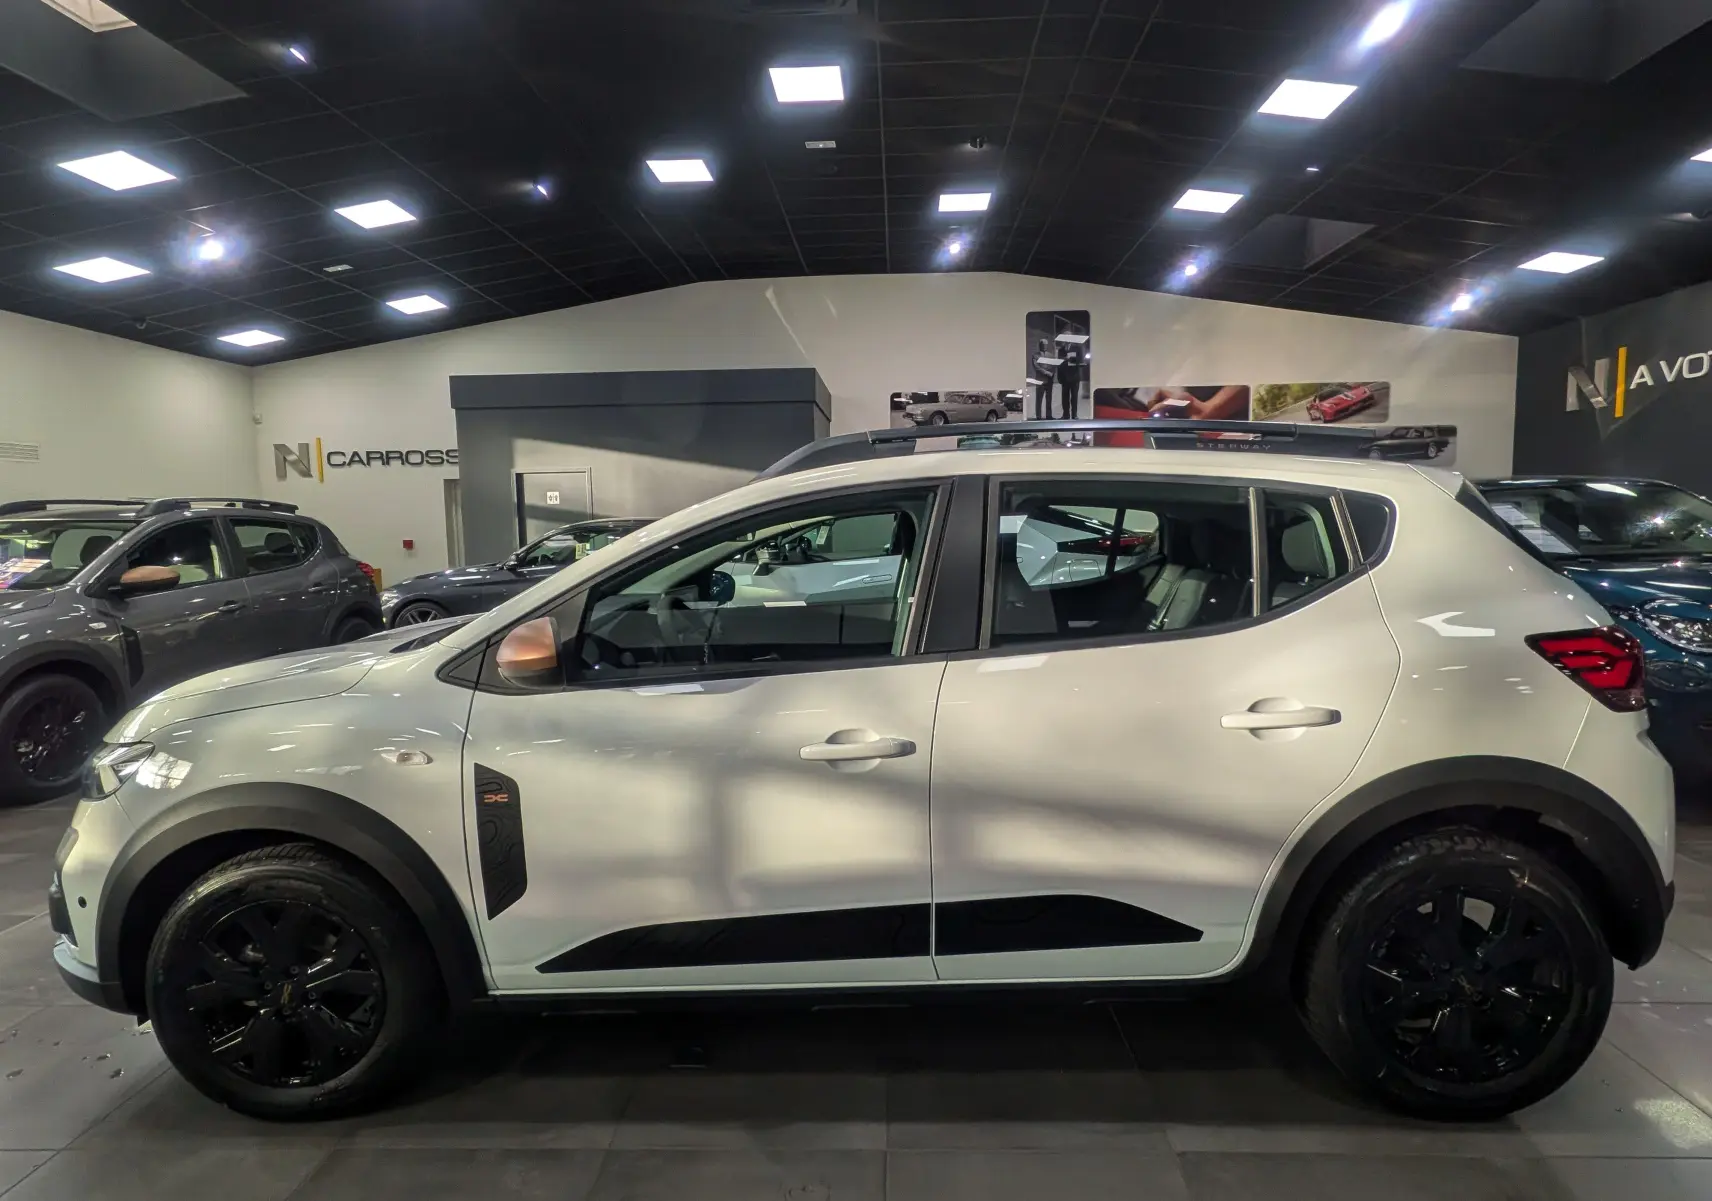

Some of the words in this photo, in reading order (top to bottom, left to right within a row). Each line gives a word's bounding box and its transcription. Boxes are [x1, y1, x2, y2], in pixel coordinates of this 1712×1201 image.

[1629, 364, 1655, 390] A
[1659, 350, 1712, 382] VO
[326, 449, 459, 468] CARROSS
